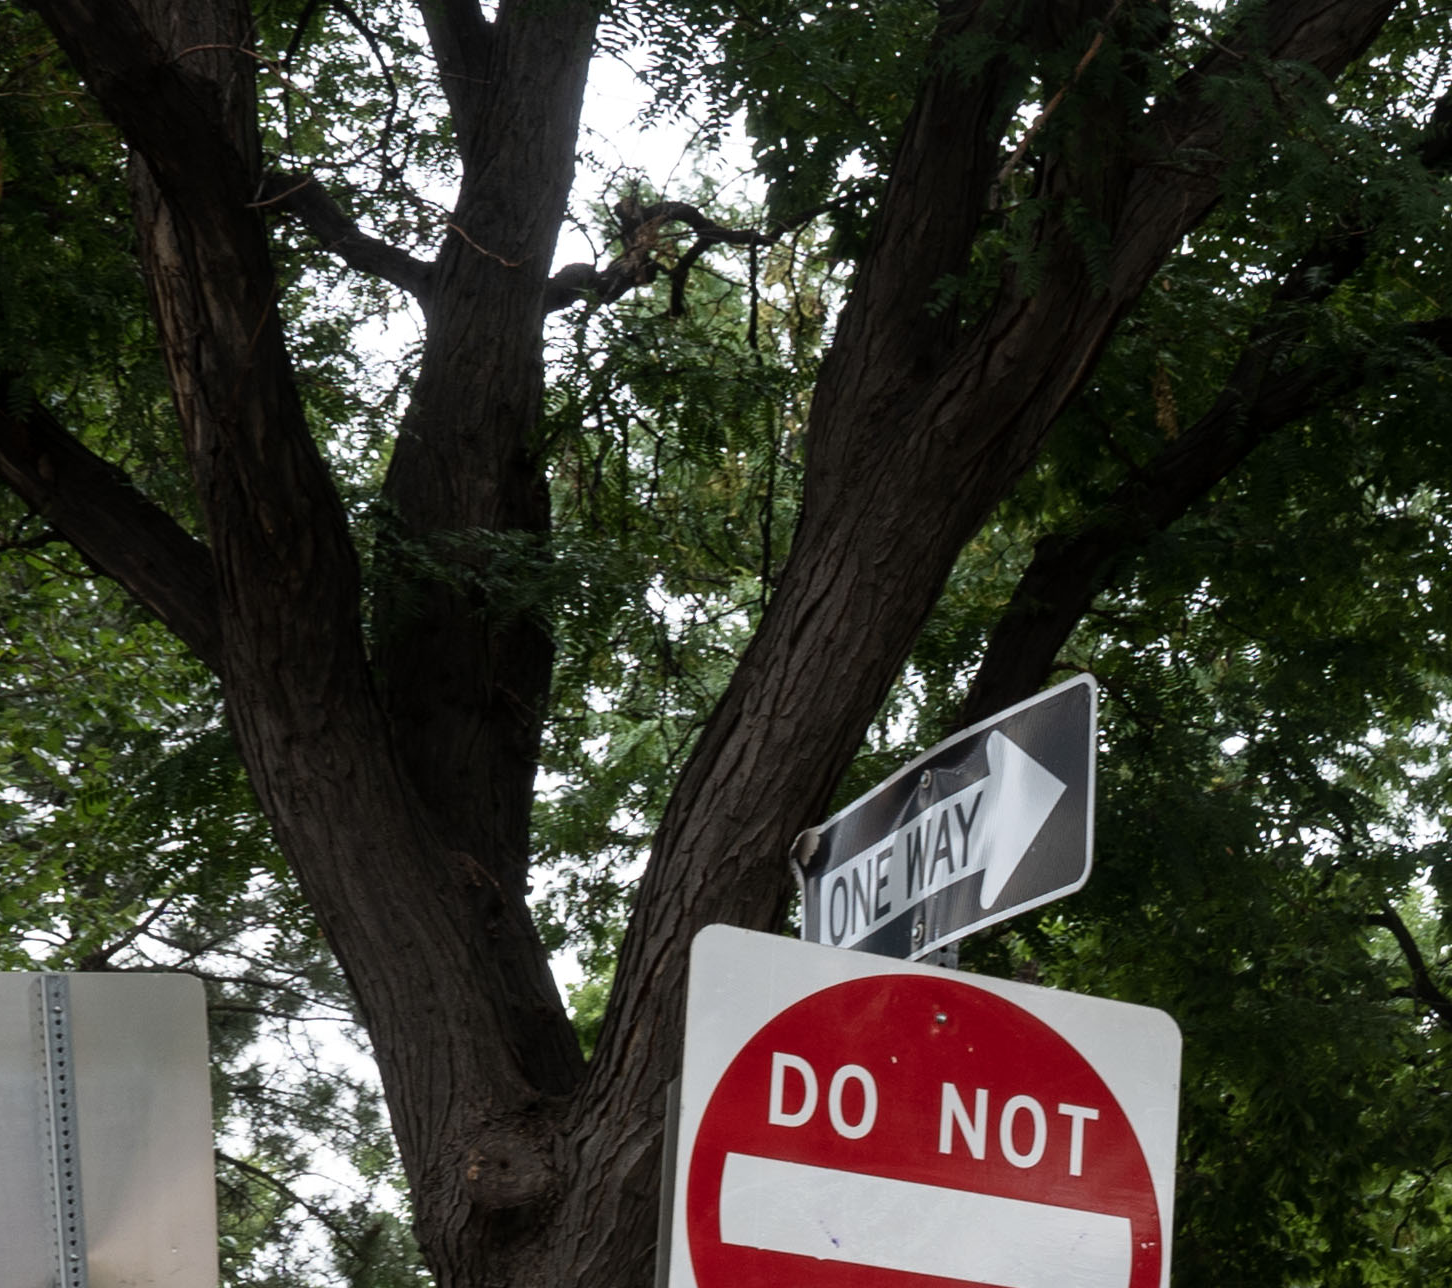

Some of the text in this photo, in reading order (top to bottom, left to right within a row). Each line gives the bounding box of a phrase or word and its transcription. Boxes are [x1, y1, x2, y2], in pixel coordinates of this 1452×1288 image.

[830, 790, 984, 945] ONE WAY
[769, 1051, 1099, 1177] DO NOT
